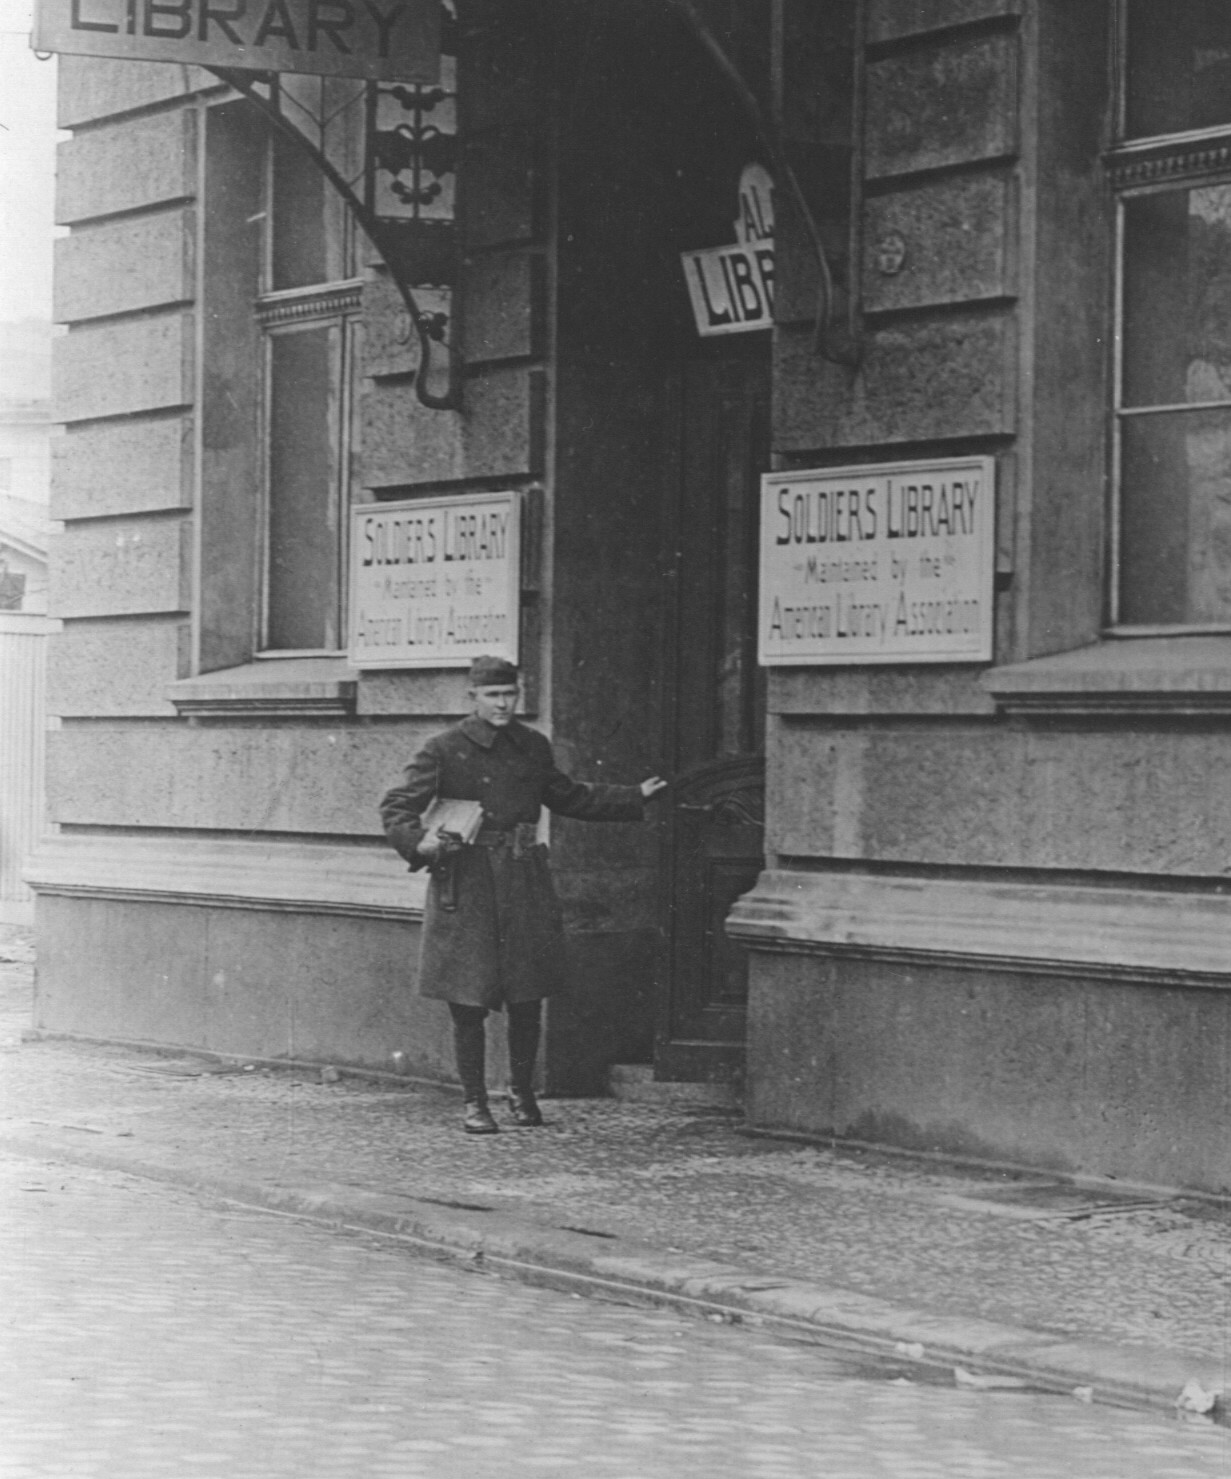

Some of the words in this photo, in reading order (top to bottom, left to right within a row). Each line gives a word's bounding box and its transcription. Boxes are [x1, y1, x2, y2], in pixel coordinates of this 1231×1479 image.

[362, 517, 436, 566] SOLDIERS
[444, 510, 510, 561] LIBRARY
[776, 488, 877, 545] SOLDIERS
[887, 480, 979, 538] LIBRARY
[769, 596, 831, 639] American
